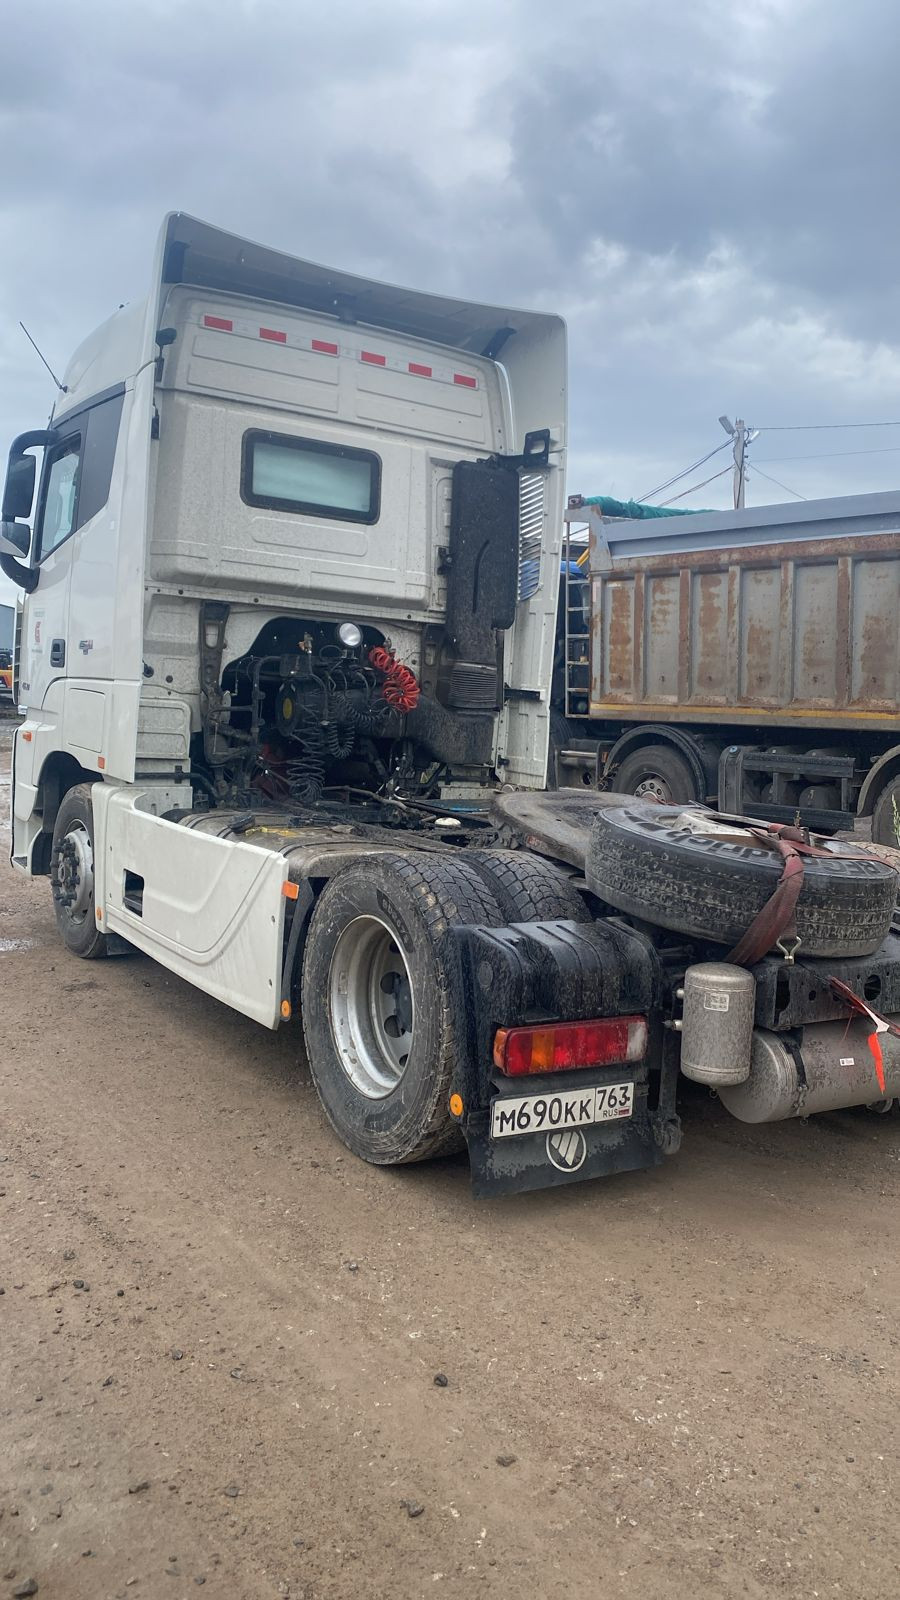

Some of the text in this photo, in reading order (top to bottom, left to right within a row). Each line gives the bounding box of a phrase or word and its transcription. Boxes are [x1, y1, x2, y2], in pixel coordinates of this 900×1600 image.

[499, 1086, 629, 1133] М690КК 763
[602, 1109, 619, 1118] RUS
